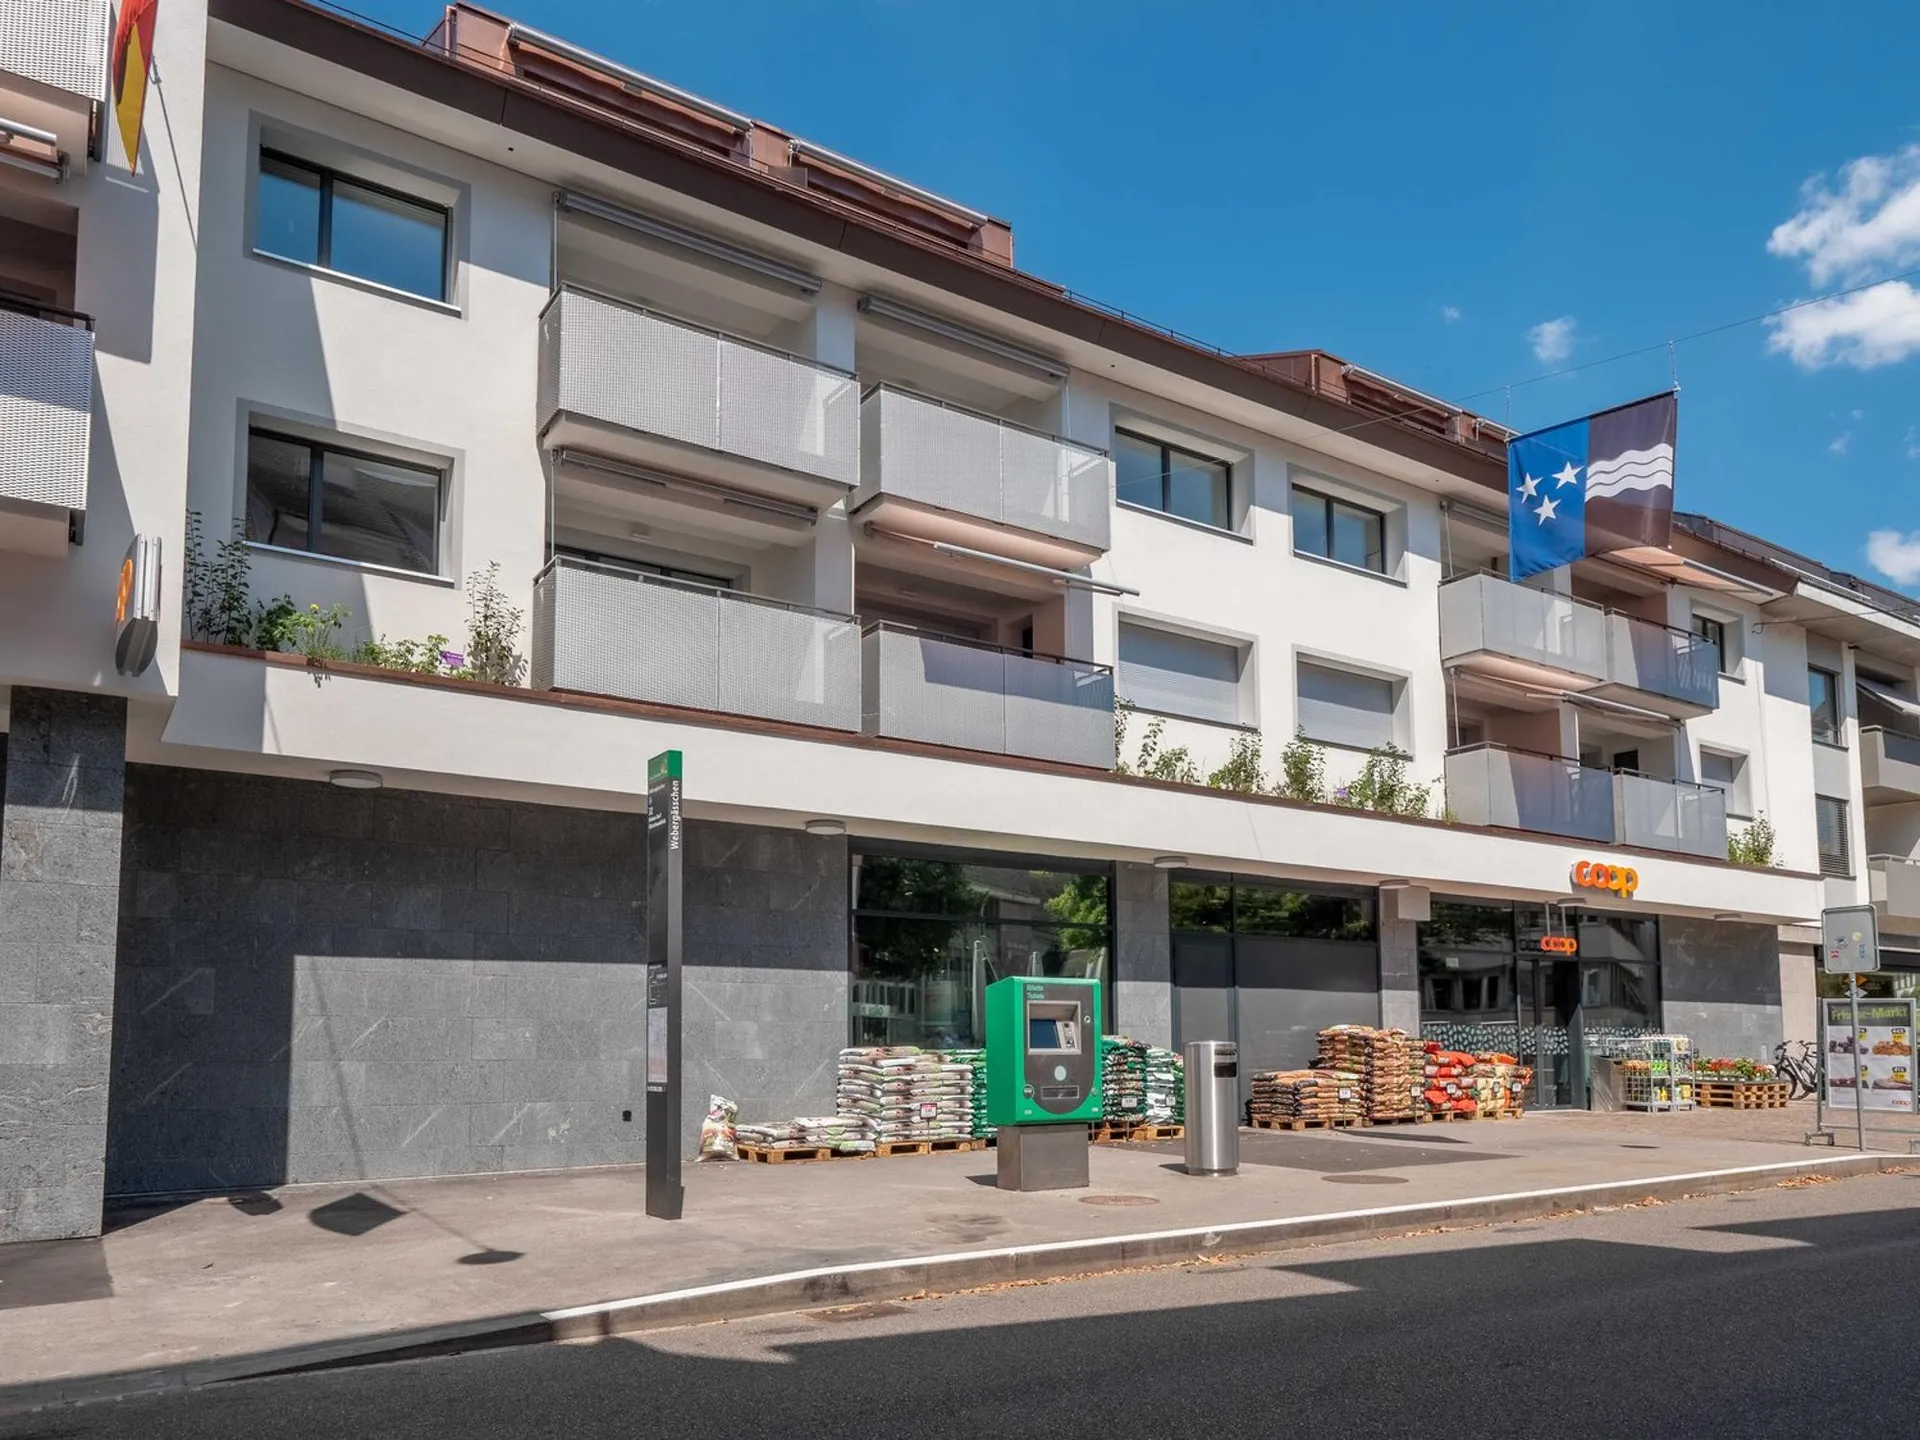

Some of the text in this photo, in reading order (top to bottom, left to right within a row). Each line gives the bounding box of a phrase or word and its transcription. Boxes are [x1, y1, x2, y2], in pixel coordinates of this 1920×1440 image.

[670, 780, 681, 850] Webergässchen
[1575, 860, 1639, 899] coop
[1541, 935, 1577, 955] coop
